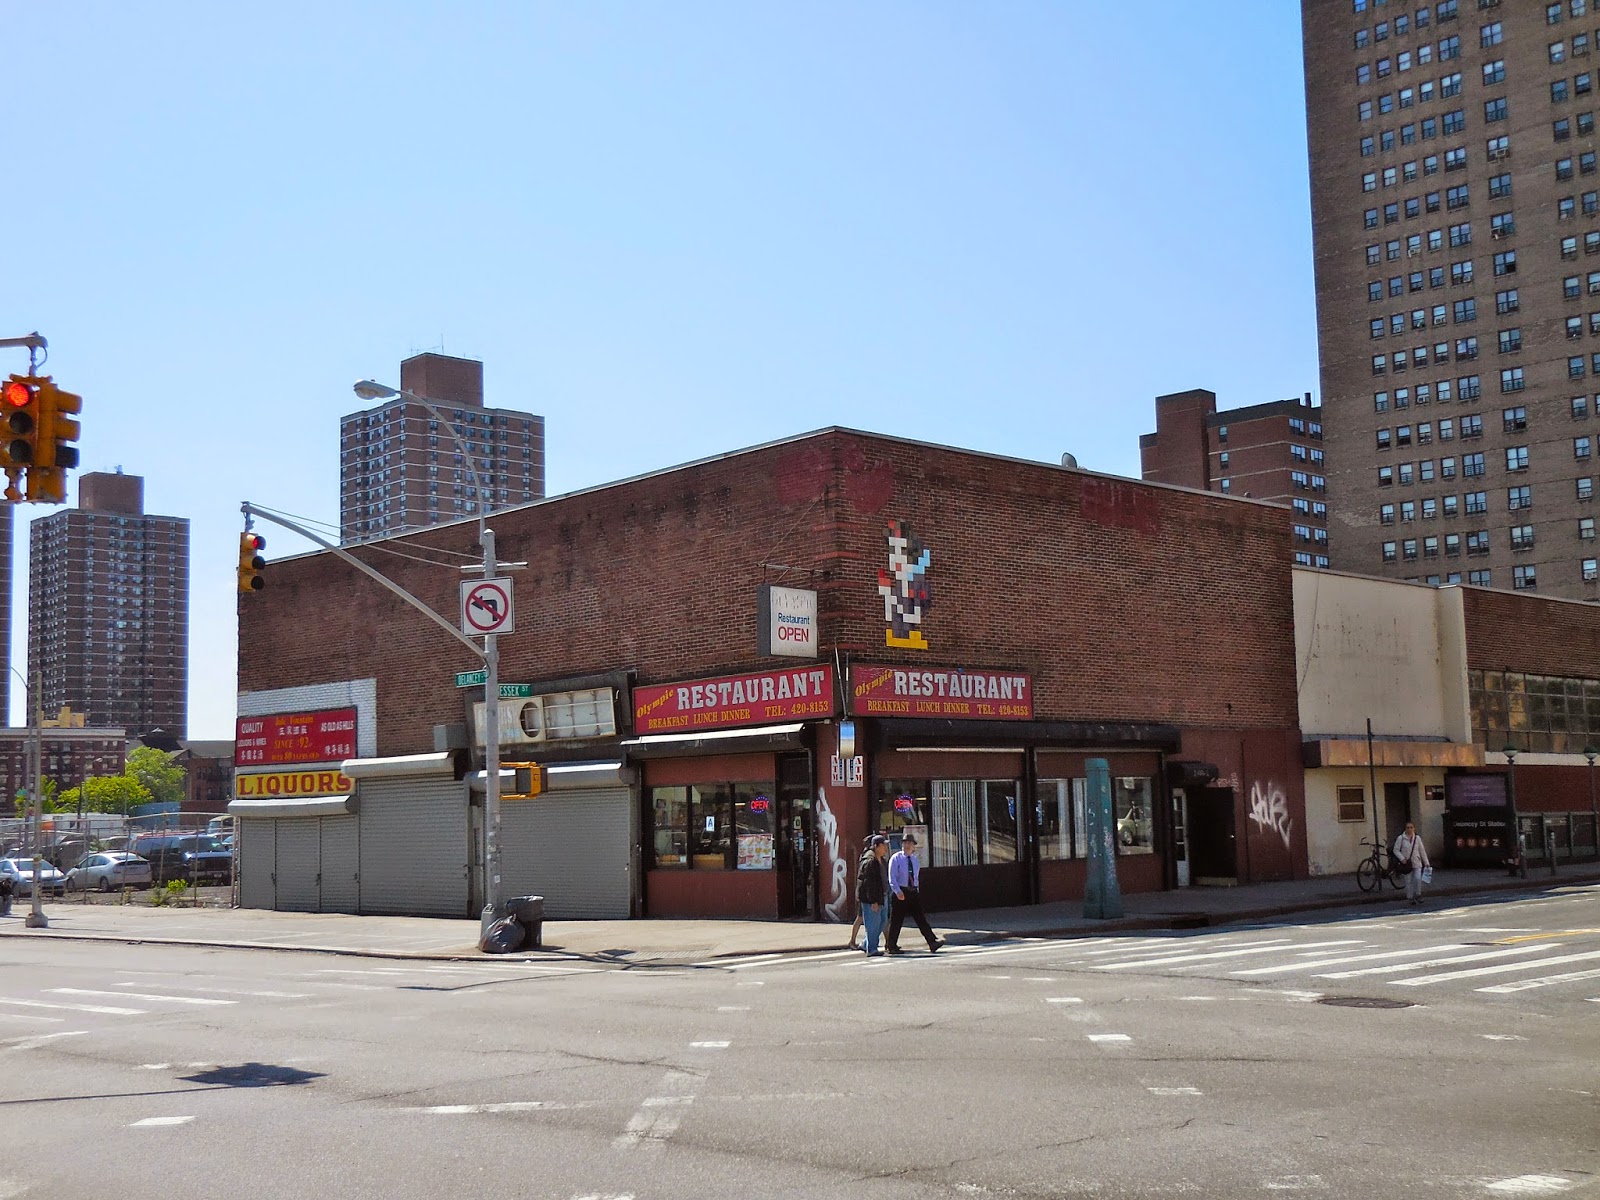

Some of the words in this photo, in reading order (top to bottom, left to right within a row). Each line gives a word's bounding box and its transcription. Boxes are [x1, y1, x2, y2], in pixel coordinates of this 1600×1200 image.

[777, 612, 810, 625] Restaurant
[778, 626, 809, 642] OPEN
[457, 673, 481, 686] DELANCEY
[855, 669, 893, 697] Olympic
[894, 671, 1026, 700] RESTAURANT
[499, 685, 520, 696] ESSEX
[636, 689, 674, 718] Olympic
[677, 671, 825, 710] RESTAURANT
[867, 700, 910, 713] BREAKFAST
[916, 701, 940, 713] LUNCH
[943, 702, 970, 714] DINNER
[976, 704, 995, 715] TEL:
[998, 705, 1029, 716] 420-8153
[290, 715, 314, 725] Fountain
[648, 715, 689, 729] BREAKFAST
[693, 711, 718, 724] LUNCH
[721, 708, 751, 722] DINNER
[765, 705, 787, 718] TEL:
[791, 701, 829, 714] 420-8153
[241, 722, 264, 734] QUALITY
[327, 721, 336, 731] OLD
[274, 740, 294, 749] SINCE
[239, 773, 352, 796] LIQUORS
[750, 800, 769, 810] OPEN
[1492, 838, 1499, 846] Z
